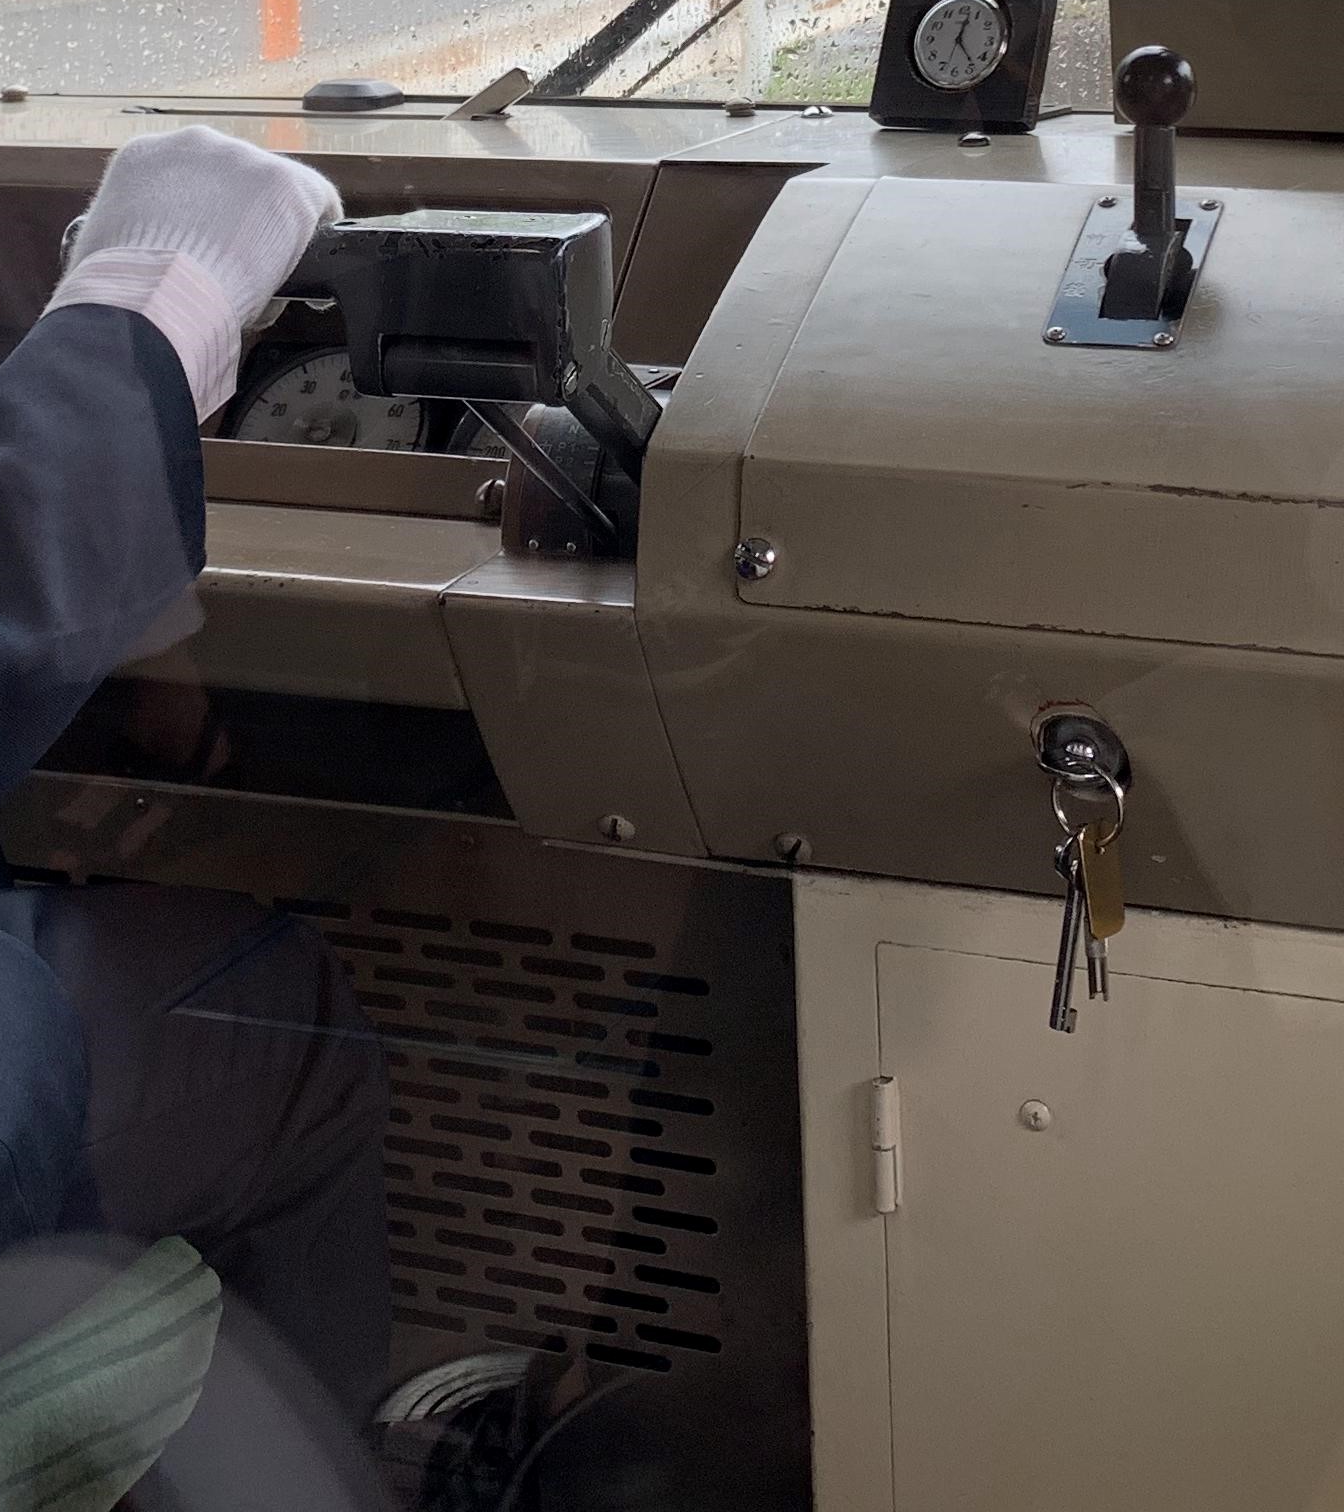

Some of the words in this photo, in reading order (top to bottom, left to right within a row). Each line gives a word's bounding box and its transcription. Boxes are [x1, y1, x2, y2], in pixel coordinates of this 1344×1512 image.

[943, 9, 955, 19] 11
[974, 9, 982, 20] 1
[931, 21, 944, 31] 10
[983, 21, 993, 31] 2
[926, 35, 935, 45] 9
[984, 36, 994, 47] 3
[928, 49, 938, 61] 8
[976, 50, 988, 62] 4
[938, 61, 949, 71] 7
[964, 63, 975, 74] 5
[950, 66, 959, 78] 6
[300, 380, 317, 395] 30
[270, 403, 288, 417] 20
[387, 404, 405, 418] 60
